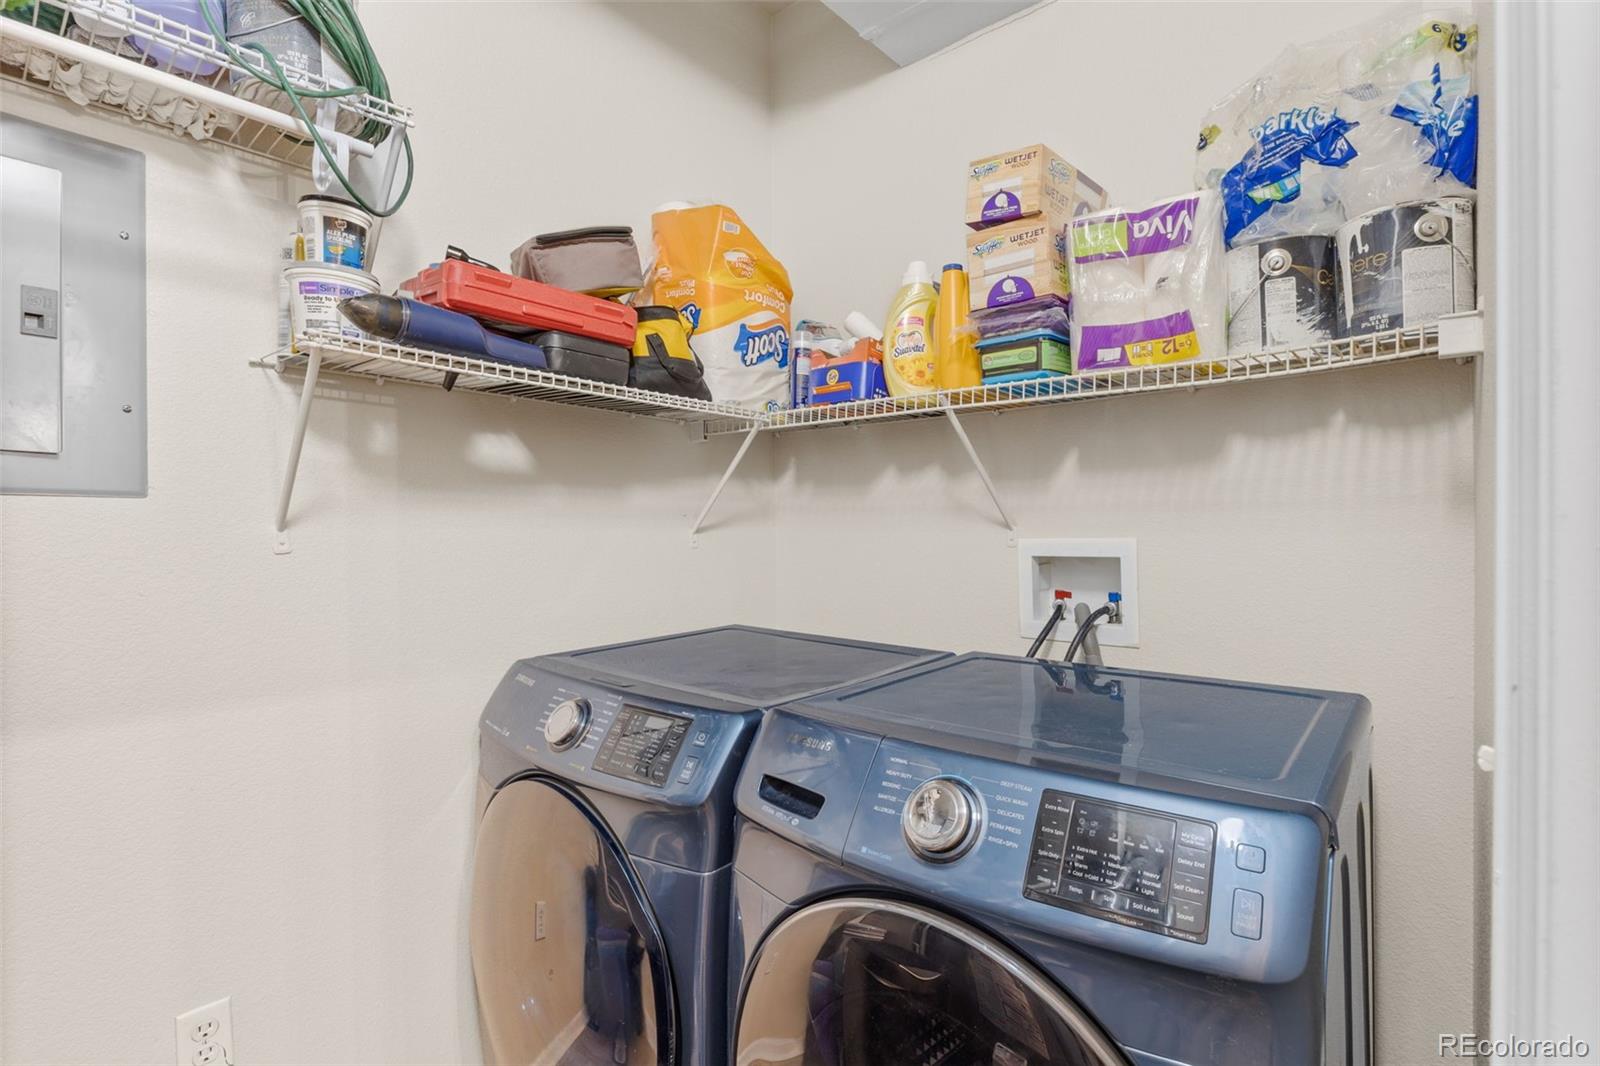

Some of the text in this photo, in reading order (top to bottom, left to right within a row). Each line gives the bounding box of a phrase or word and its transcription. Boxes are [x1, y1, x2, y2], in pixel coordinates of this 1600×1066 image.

[1004, 151, 1038, 165] WETJET
[1011, 160, 1030, 169] WOOD
[1133, 209, 1193, 241] Viva
[1009, 227, 1046, 243] WETJET
[1017, 237, 1039, 247] WOOD
[665, 287, 696, 299] Comfort
[744, 288, 786, 315] Comfort
[745, 329, 786, 367] Scott
[1044, 803, 1057, 811] Extra
[996, 809, 1025, 820] DELICATES
[1005, 825, 1022, 835] PRESS
[1041, 826, 1065, 836] Extra Spin
[1177, 857, 1206, 869] Delay End
[1142, 879, 1162, 889] Normal
[1141, 887, 1155, 896] Light
[1132, 902, 1160, 914] Soil Level
[1176, 913, 1194, 922] Sound
